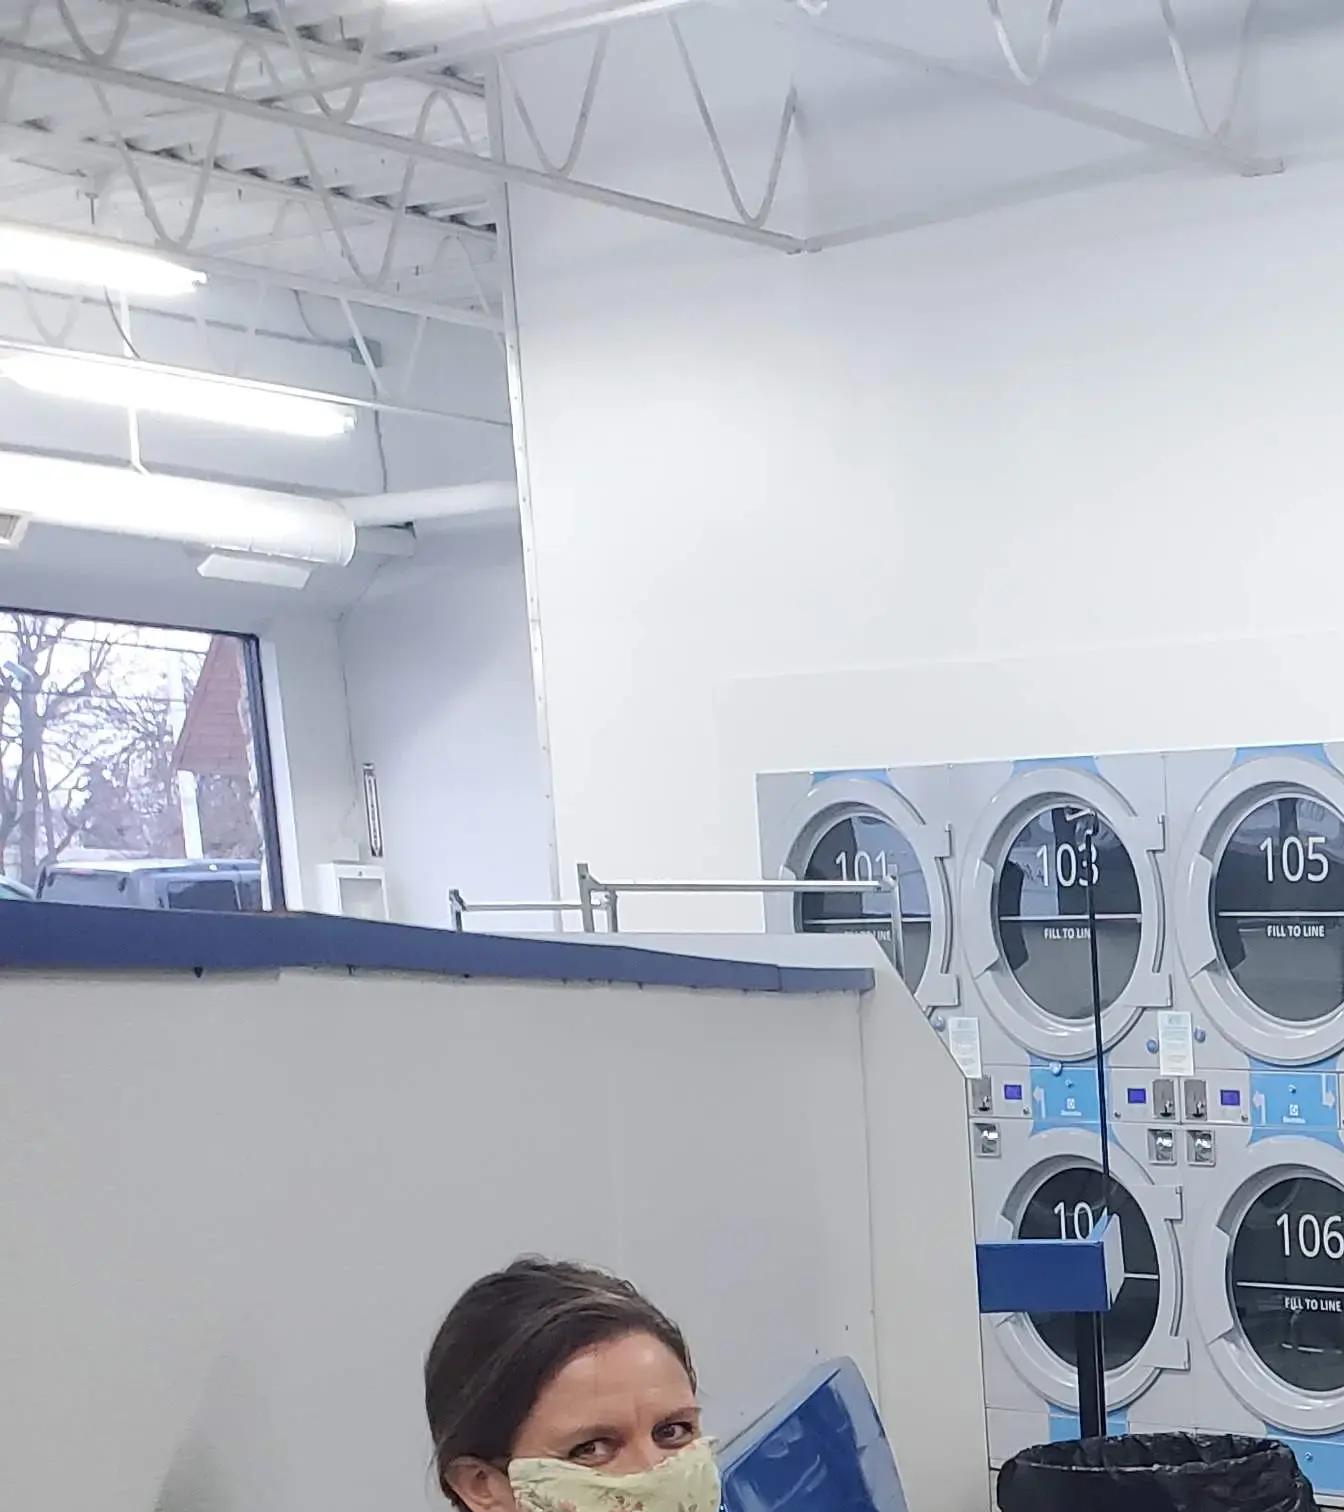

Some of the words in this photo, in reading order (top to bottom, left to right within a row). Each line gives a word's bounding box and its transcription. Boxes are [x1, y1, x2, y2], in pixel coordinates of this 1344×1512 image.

[835, 850, 887, 882] 101
[1036, 843, 1099, 887] 103
[1260, 836, 1329, 882] 105
[1044, 927, 1061, 939] FILL
[1062, 927, 1075, 939] TO
[1076, 927, 1091, 939] LIN
[1267, 925, 1286, 937] FILL
[1287, 925, 1301, 937] TO
[1302, 925, 1325, 937] LINE
[1054, 1201, 1107, 1240] 10
[1276, 1213, 1344, 1259] 106
[1285, 1296, 1303, 1310] FILL
[1304, 1298, 1319, 1310] TO
[1320, 1299, 1342, 1312] LINE
